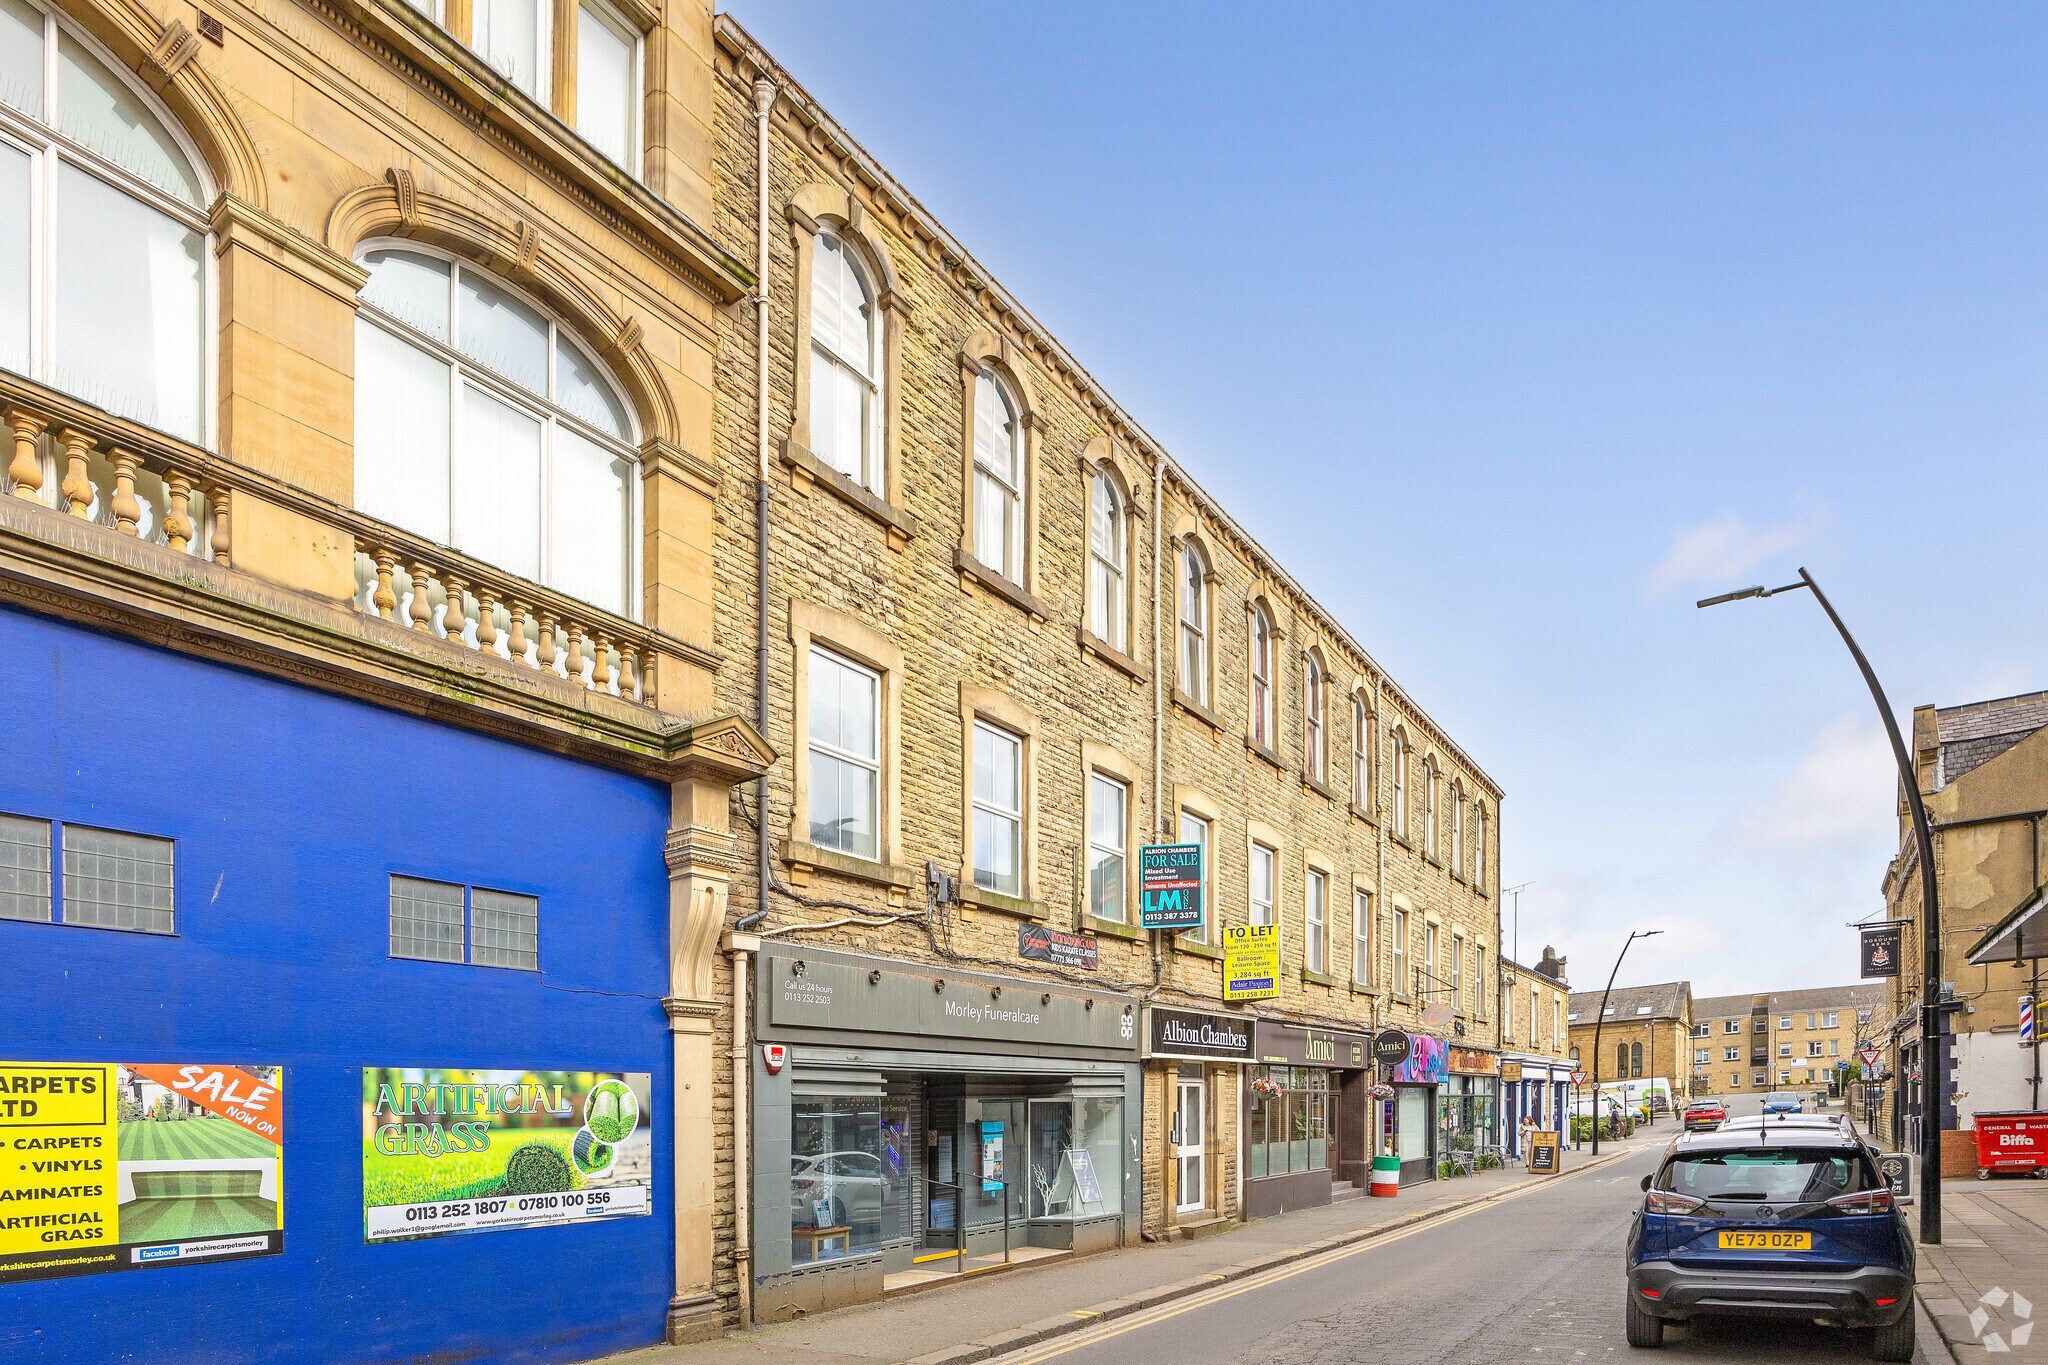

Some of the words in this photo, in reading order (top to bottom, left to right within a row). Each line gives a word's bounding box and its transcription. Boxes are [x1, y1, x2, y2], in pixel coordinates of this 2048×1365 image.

[1145, 855, 1167, 868] FOR
[1170, 854, 1198, 866] SALE
[1145, 890, 1182, 911] LM
[1228, 928, 1245, 938] TO
[1251, 926, 1273, 936] LET
[785, 980, 797, 989] Call
[807, 983, 814, 991] 24
[816, 984, 833, 993] hours
[784, 992, 801, 1001] 0113
[802, 994, 814, 1003] 252
[816, 996, 831, 1005] 2503
[945, 1000, 982, 1022] Morley
[985, 1005, 1040, 1024] Funeralcare
[1163, 1020, 1199, 1043] Albion
[1201, 1024, 1247, 1047] Chambers
[1306, 1030, 1334, 1061] Amici
[1378, 1040, 1406, 1052] Amici
[172, 1066, 275, 1110] SALE
[373, 1083, 572, 1116] ARTIFICIAL
[0, 1100, 38, 1117] TD
[226, 1105, 257, 1126] NOW
[257, 1121, 276, 1136] ON
[14, 1136, 102, 1150] CARPETS
[374, 1122, 491, 1158] GRASS
[2000, 1134, 2034, 1145] Biffa
[32, 1159, 103, 1173] VINYLS
[406, 1206, 437, 1221] 0113
[442, 1203, 470, 1218] 252
[475, 1200, 507, 1214] 1807
[519, 1196, 558, 1210] 07810
[562, 1194, 583, 1207] 100
[587, 1192, 610, 1204] 556
[372, 1221, 465, 1236] philip.walker1@googlemail.com
[476, 1212, 565, 1225] www.yorkshirecarpetsmorley.co.uk
[41, 1227, 103, 1242] GRASS
[1726, 1234, 1766, 1247] YE73
[1772, 1234, 1804, 1247] OZP
[143, 1248, 177, 1258] facebook
[185, 1240, 263, 1254] yorkshirecarpetsmorley
